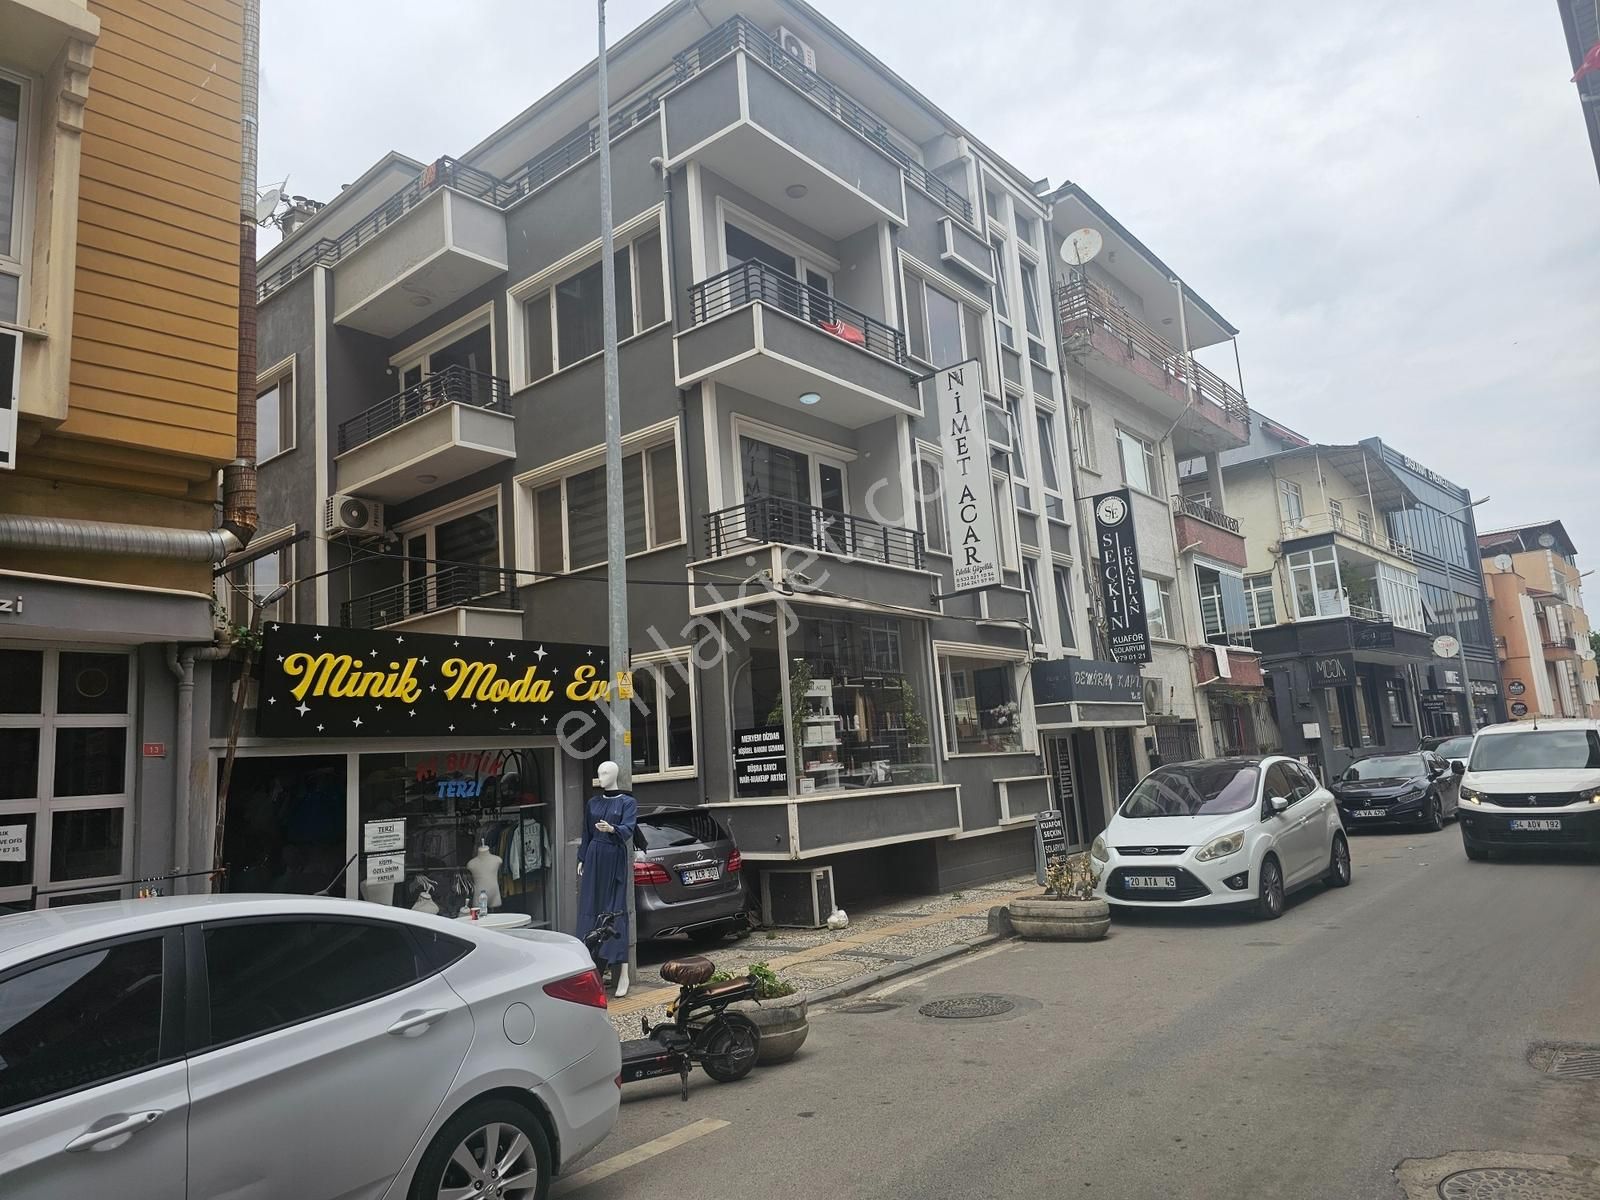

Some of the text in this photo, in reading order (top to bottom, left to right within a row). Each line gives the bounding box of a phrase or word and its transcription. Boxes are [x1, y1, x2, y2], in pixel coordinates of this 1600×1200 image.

[947, 367, 982, 565] NİMET ACAR
[1102, 533, 1124, 631] SEÇKİN
[1123, 546, 1140, 615] ERASLAN
[1112, 633, 1144, 645] KUAFÖR
[1113, 644, 1146, 654] SOLARYUM
[1316, 657, 1346, 679] MOON
[283, 652, 422, 704] Minik
[441, 657, 553, 704] Moda
[1041, 820, 1061, 829] KUAFÖR
[1545, 820, 1559, 828] 192
[1130, 876, 1175, 887] 20 ATA 45
